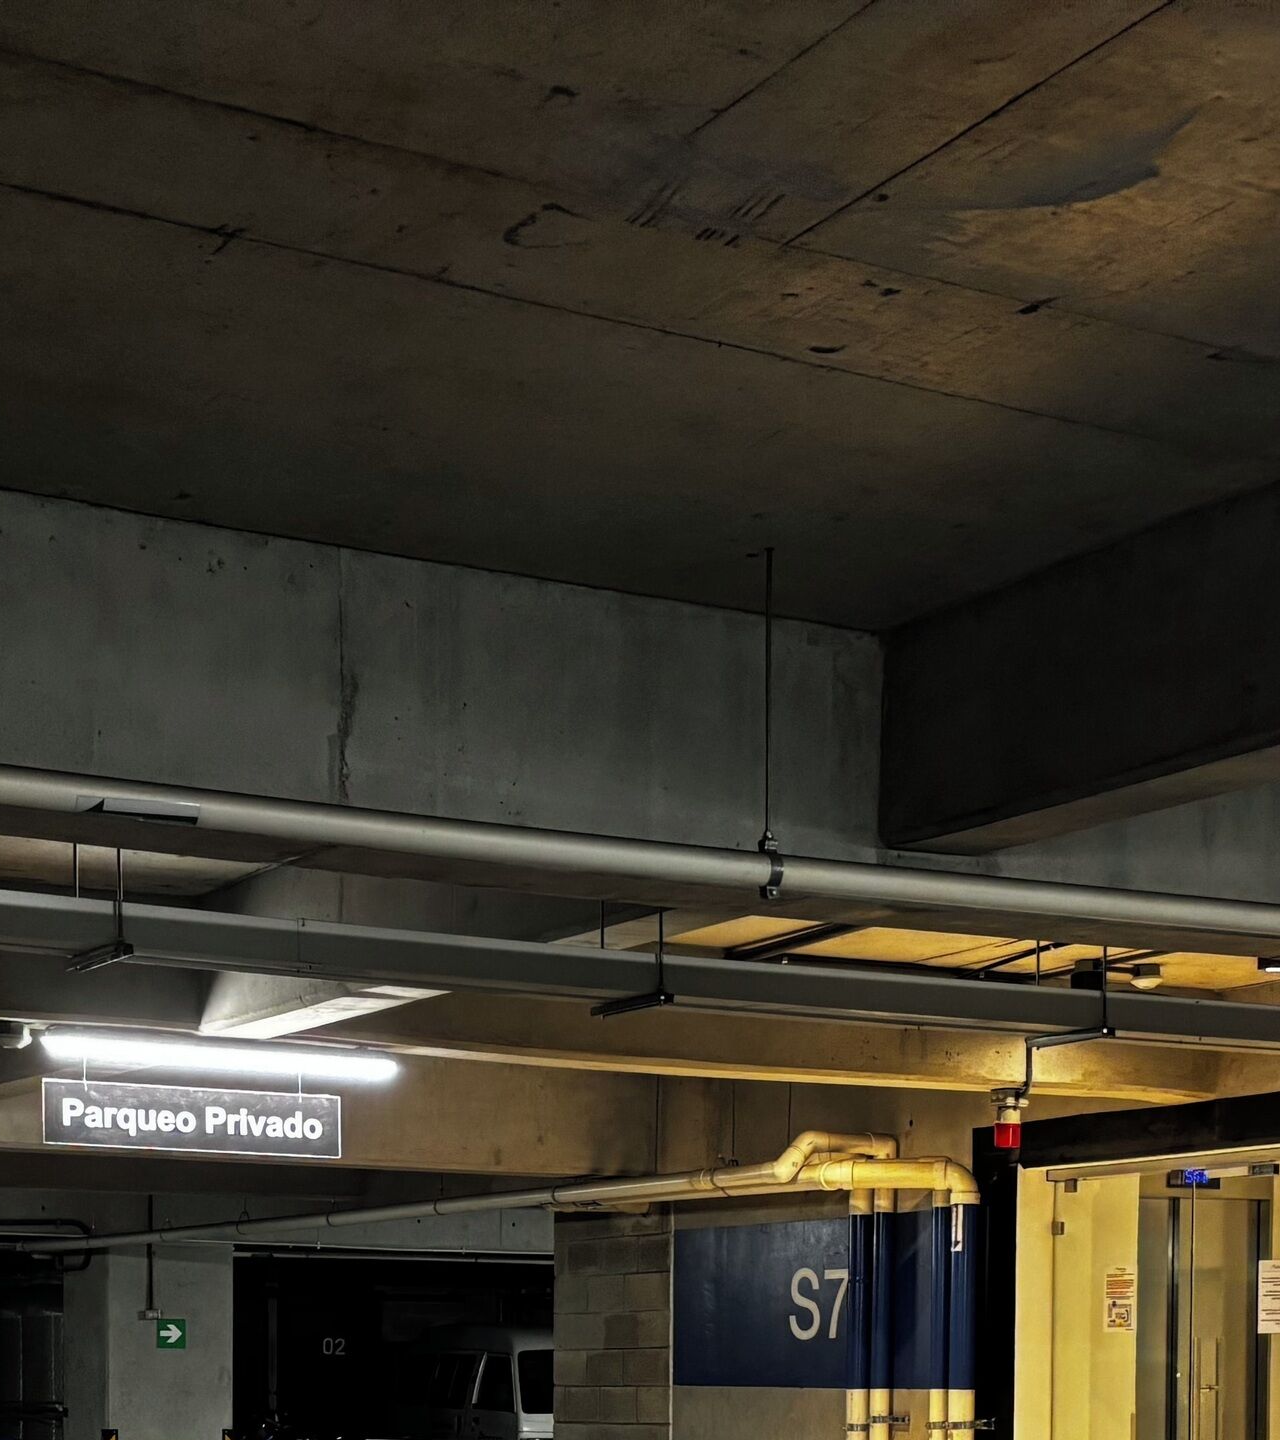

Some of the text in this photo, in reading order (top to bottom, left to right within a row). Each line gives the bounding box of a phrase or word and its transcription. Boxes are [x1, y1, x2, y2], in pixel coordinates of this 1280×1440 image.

[61, 1097, 324, 1140] Parqueo Privado
[789, 1267, 849, 1341] S7
